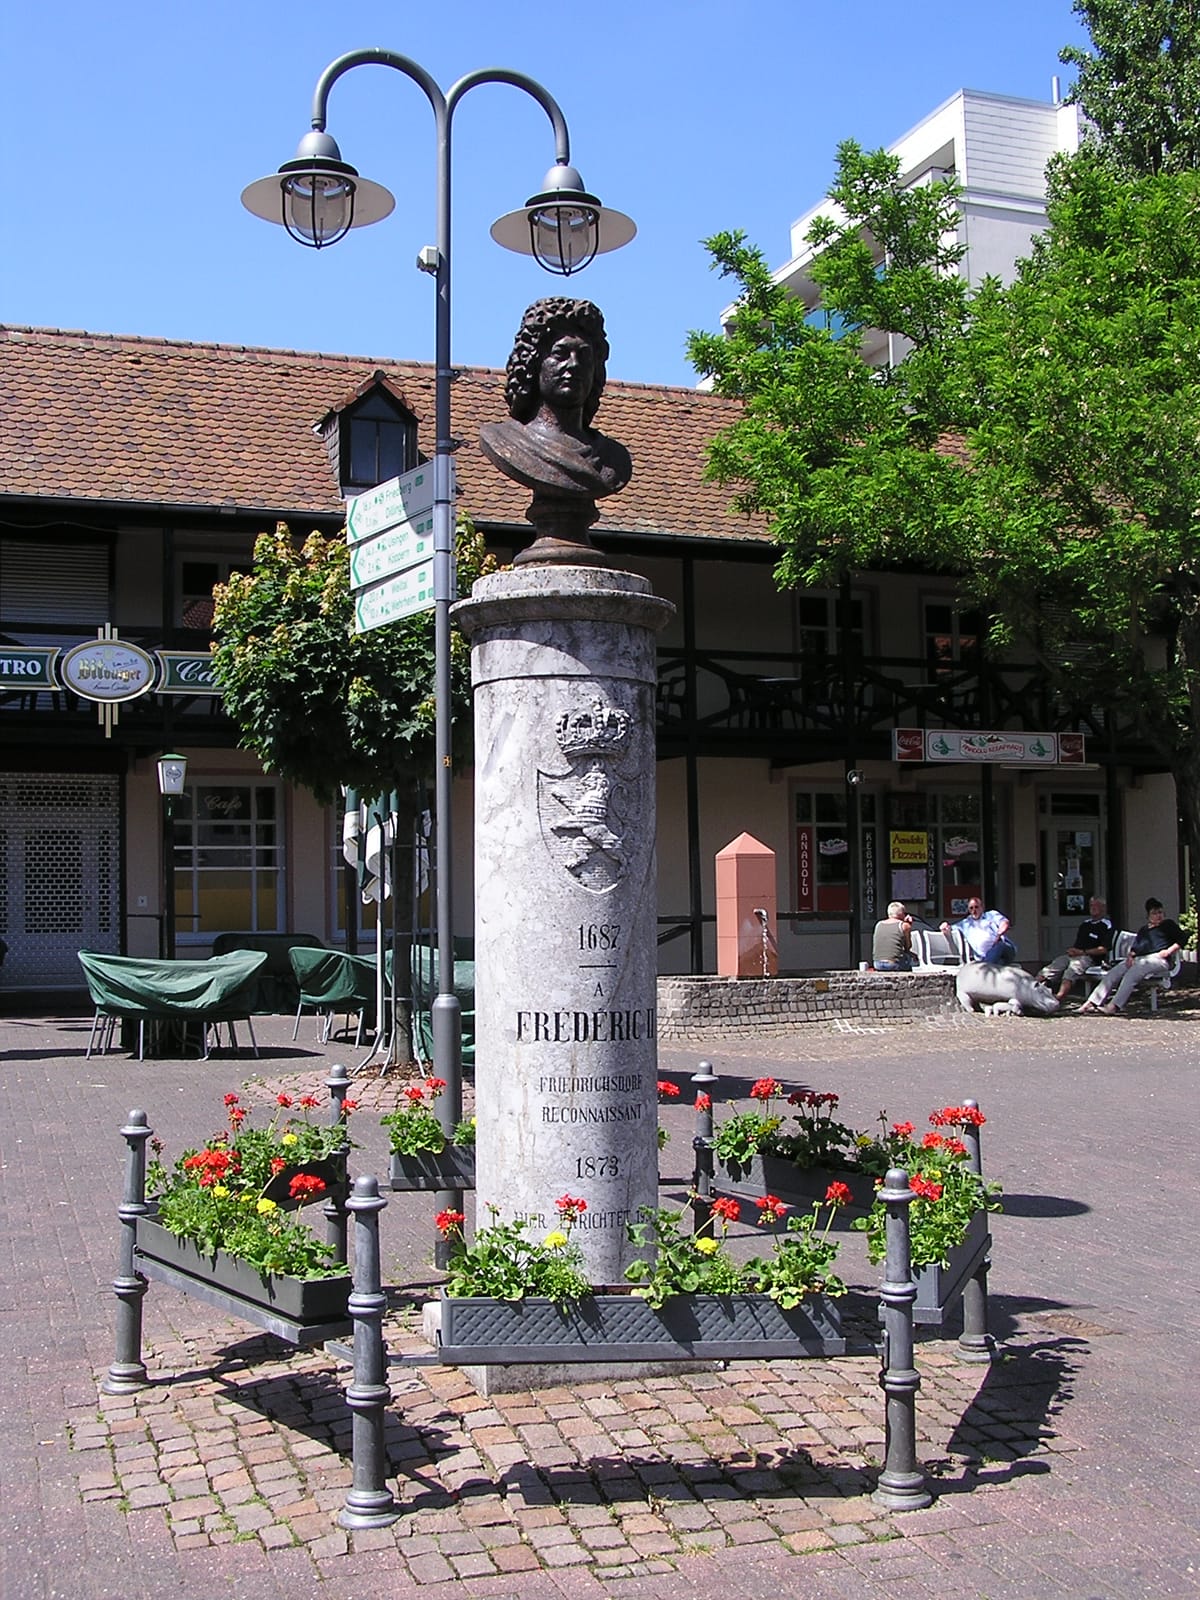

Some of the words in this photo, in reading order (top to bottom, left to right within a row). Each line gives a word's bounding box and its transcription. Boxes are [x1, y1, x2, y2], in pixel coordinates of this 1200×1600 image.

[800, 832, 809, 897] ANADOLU
[865, 832, 875, 914] KEBAPHAUS
[593, 982, 604, 997] A
[516, 1007, 641, 1043] FRÉDÉRIC
[539, 1074, 643, 1093] FRIEDRICHSDORF
[541, 1103, 642, 1123] RECONNAISSANT
[576, 1155, 619, 1179] 1873
